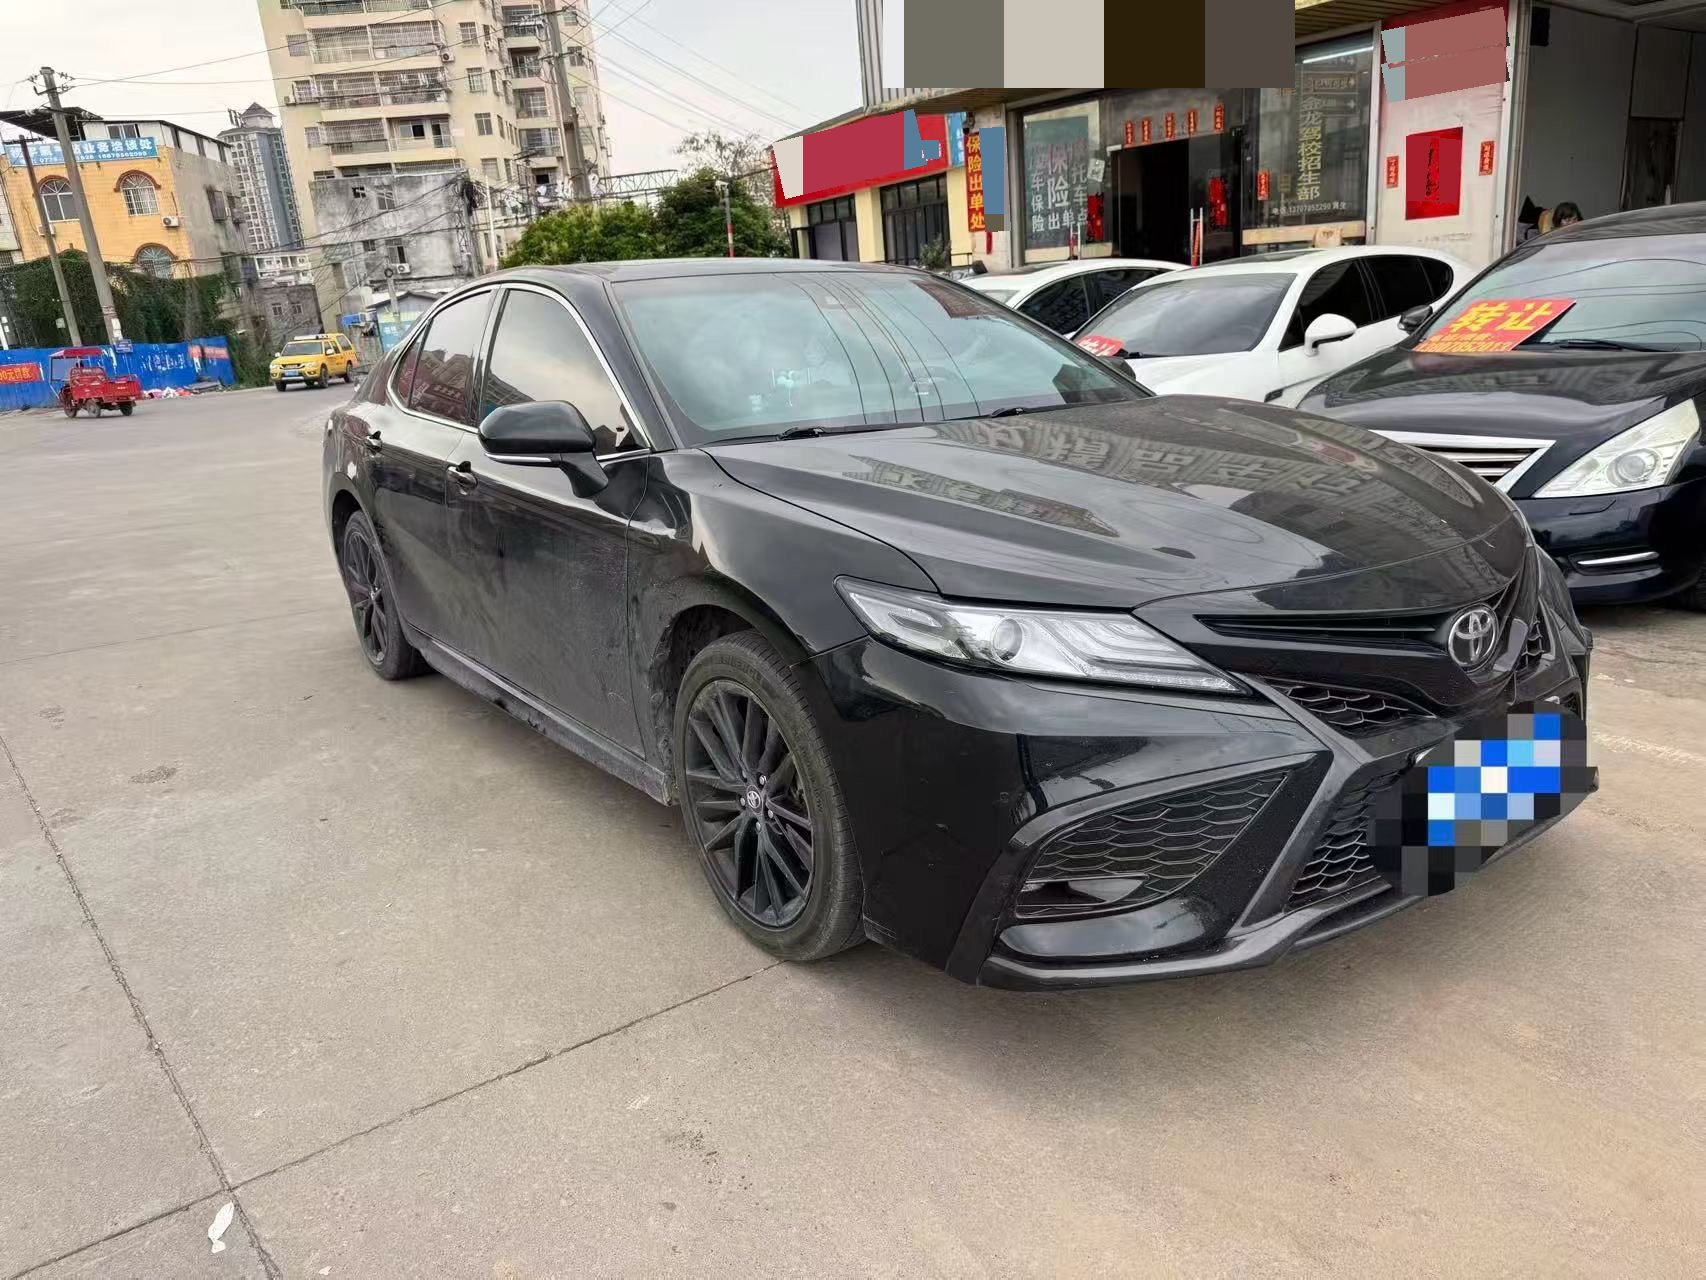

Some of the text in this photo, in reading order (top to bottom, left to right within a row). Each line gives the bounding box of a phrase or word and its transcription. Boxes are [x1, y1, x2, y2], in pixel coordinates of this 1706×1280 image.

[966, 136, 986, 230] 保险出单处
[1449, 301, 1553, 333] 转让
